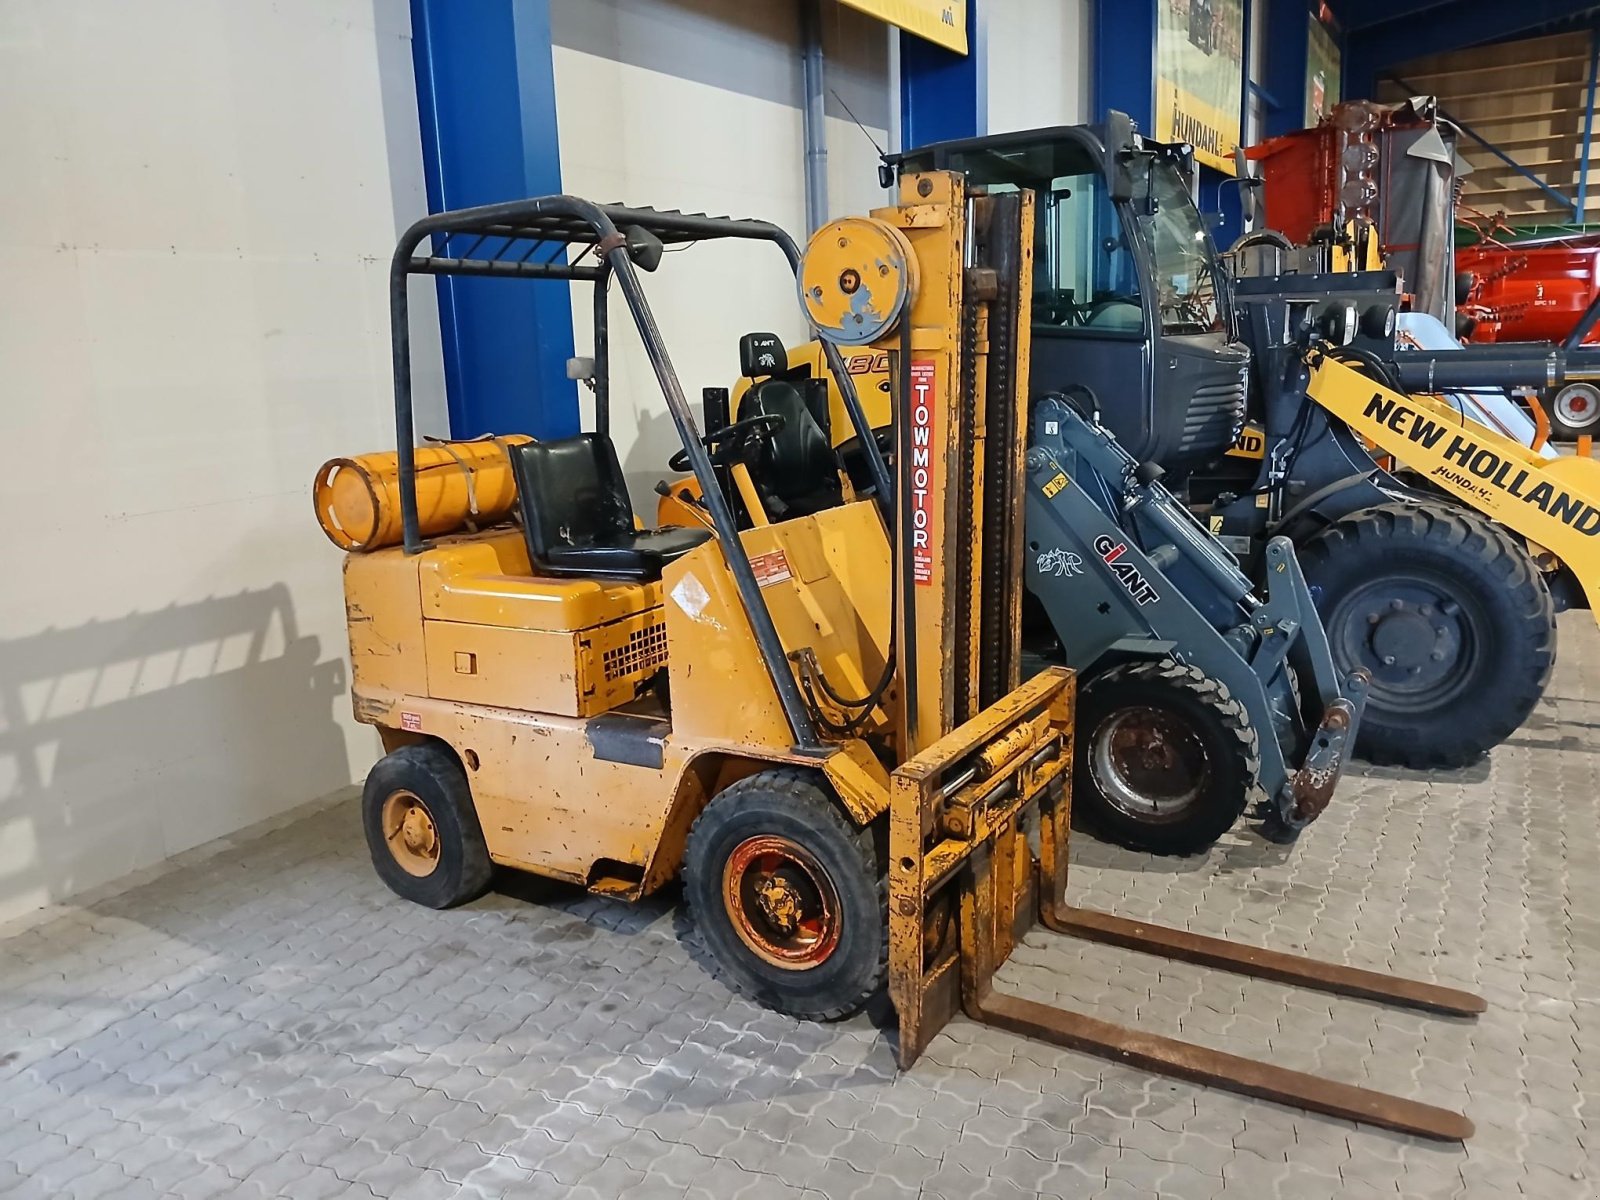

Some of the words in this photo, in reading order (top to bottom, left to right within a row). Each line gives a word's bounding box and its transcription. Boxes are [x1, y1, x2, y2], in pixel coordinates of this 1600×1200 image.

[1172, 108, 1219, 156] HUNDAHL
[913, 384, 930, 549] TOWMOTOR
[1362, 392, 1448, 450] NEW
[1442, 434, 1600, 537] HOLLAND
